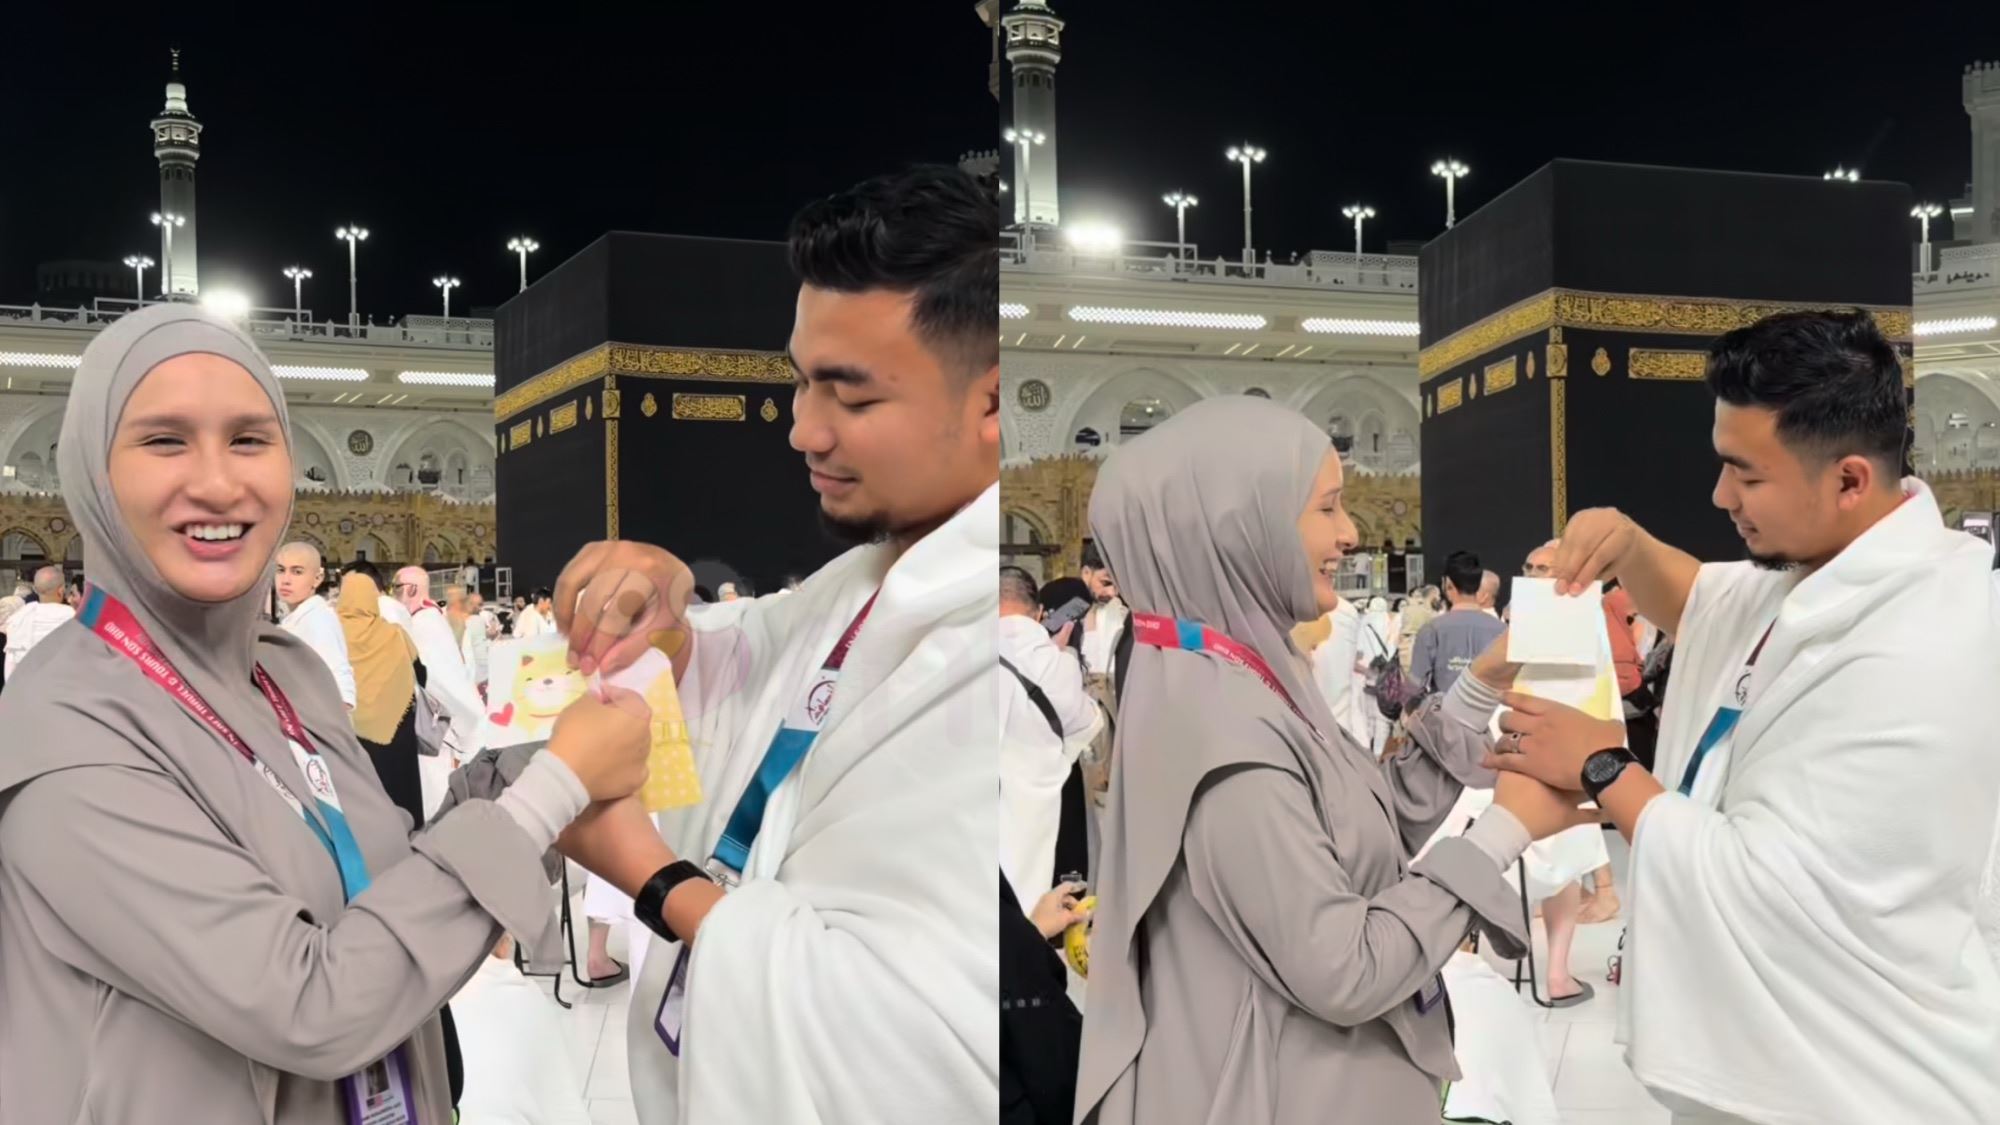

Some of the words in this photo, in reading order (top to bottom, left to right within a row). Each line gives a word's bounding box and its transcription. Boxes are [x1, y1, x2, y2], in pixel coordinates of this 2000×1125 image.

[103, 621, 125, 640] BHD
[122, 636, 143, 656] SDN
[140, 651, 170, 679] TOURS
